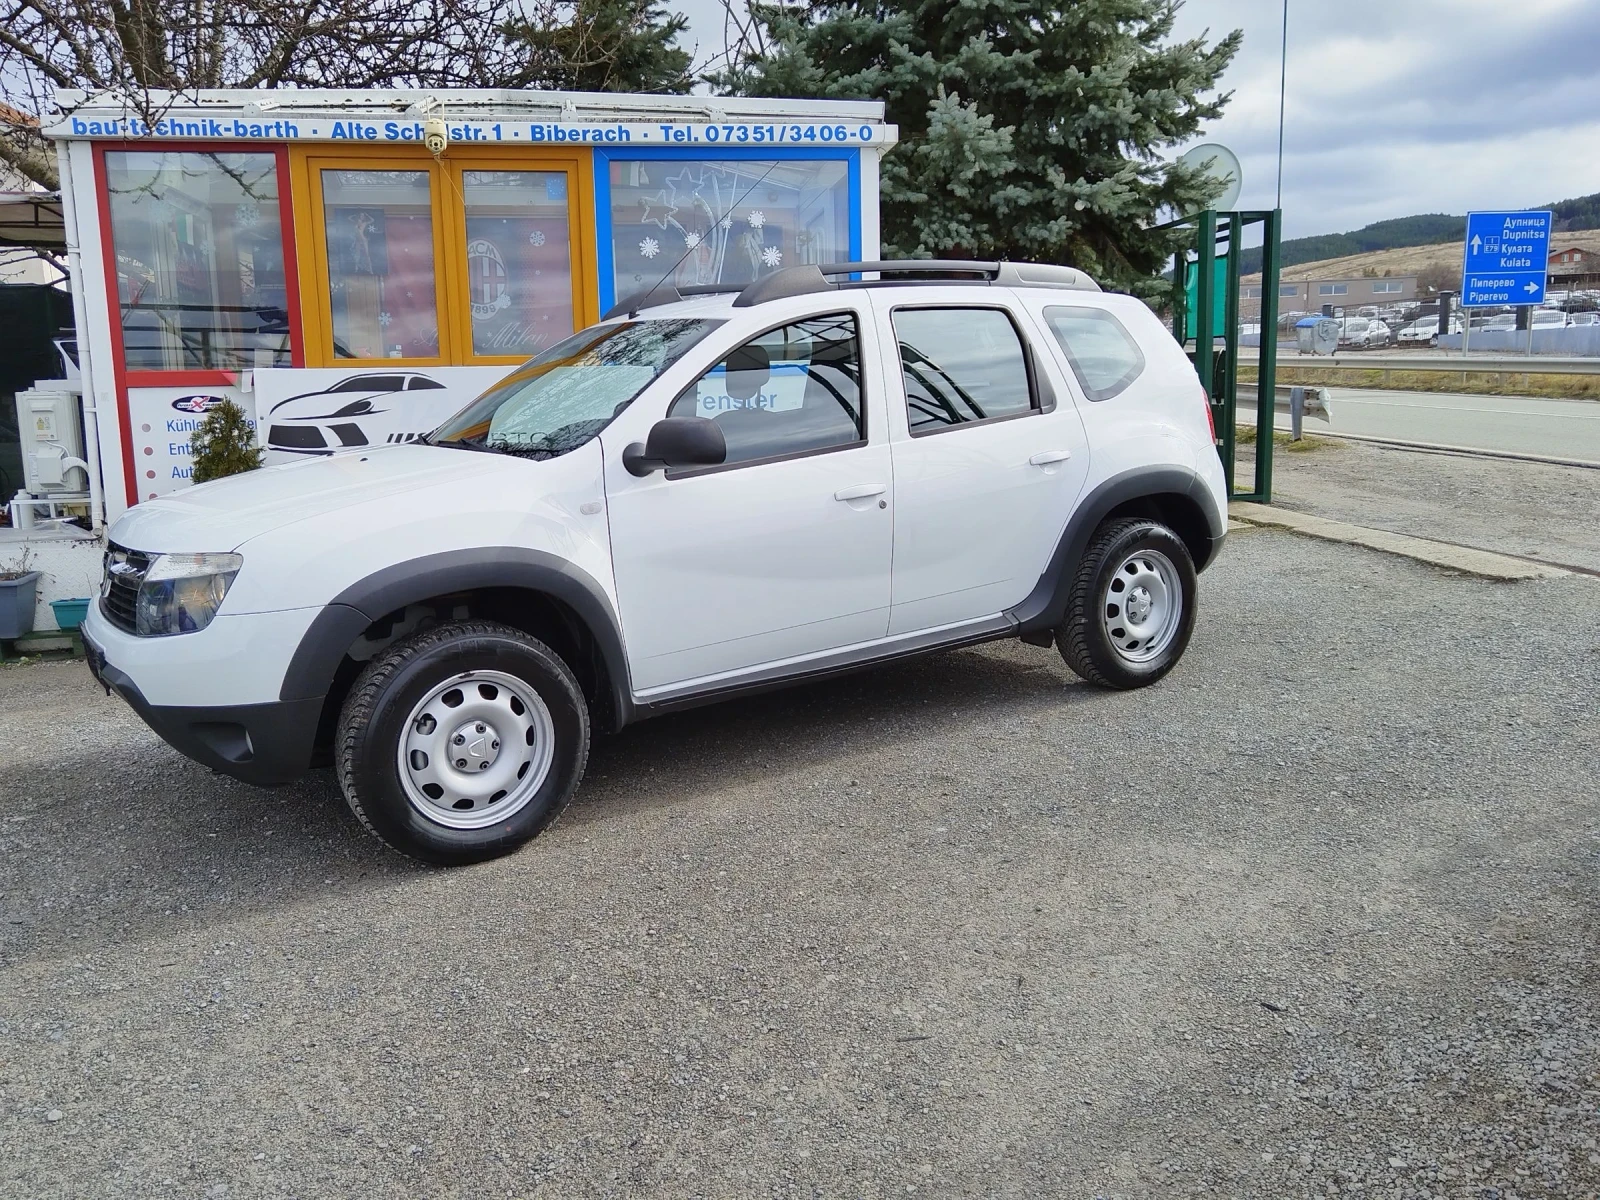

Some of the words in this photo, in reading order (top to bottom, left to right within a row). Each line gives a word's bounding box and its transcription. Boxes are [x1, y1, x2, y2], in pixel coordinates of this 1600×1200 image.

[330, 121, 377, 139] Alte
[384, 121, 487, 140] Schlstr.
[530, 124, 631, 141] Biberach
[660, 125, 699, 142] Tel.
[705, 125, 873, 142] 07351/3406-0
[1504, 217, 1545, 228] Дупница
[1503, 230, 1545, 241] Dupnitsa
[1502, 244, 1532, 255] Кулата
[1500, 257, 1531, 267] Kulata
[1470, 278, 1515, 289] Пиперево
[1469, 292, 1509, 303] Piperevo
[482, 322, 549, 349] Milan
